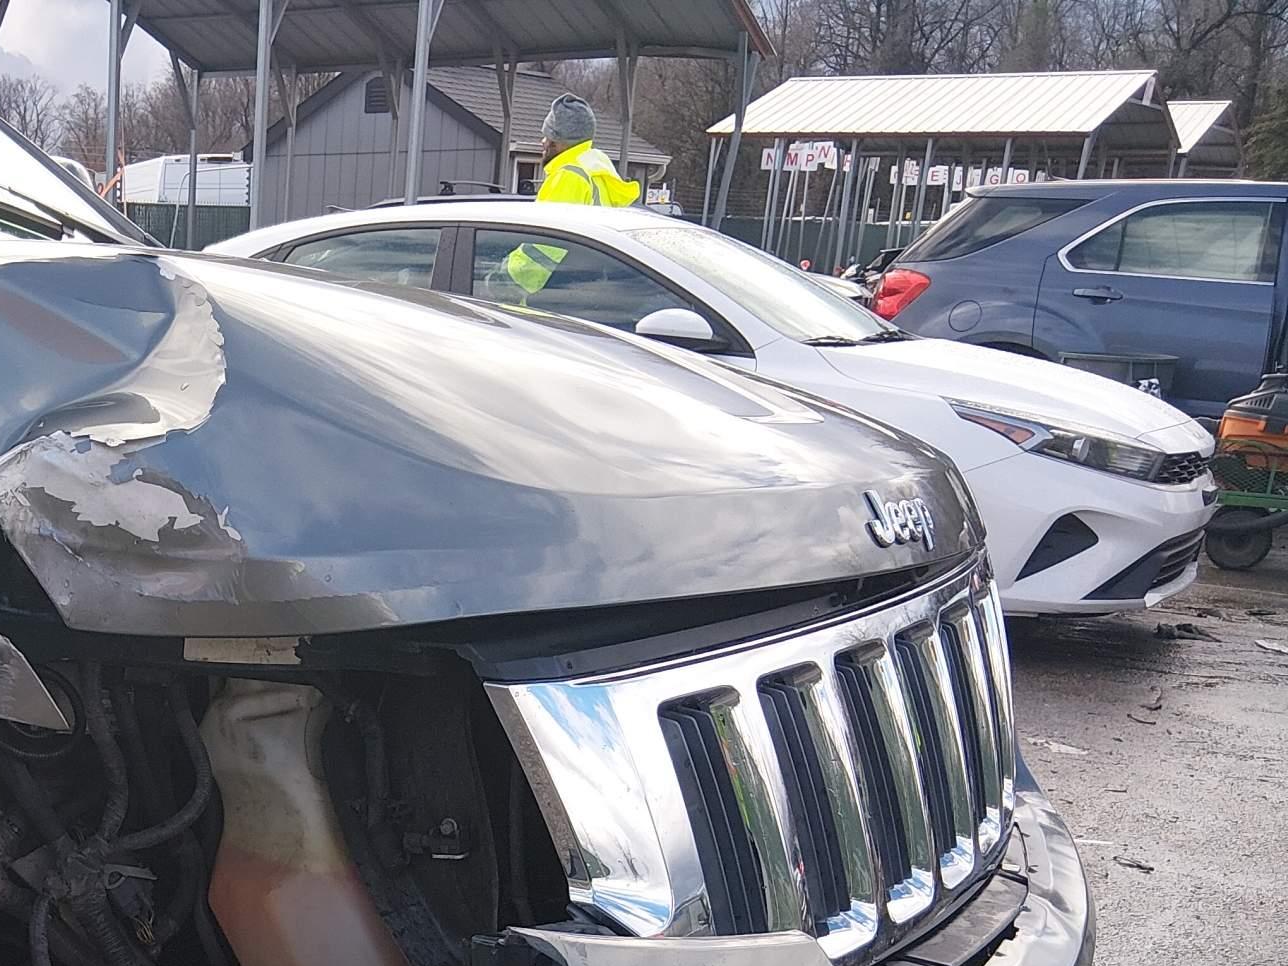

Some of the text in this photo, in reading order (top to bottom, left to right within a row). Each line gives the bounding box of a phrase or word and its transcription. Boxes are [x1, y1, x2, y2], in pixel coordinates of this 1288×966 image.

[786, 152, 798, 166] M
[806, 154, 815, 166] P
[931, 170, 939, 181] E
[990, 174, 999, 185] G
[863, 489, 934, 551] Jeep
